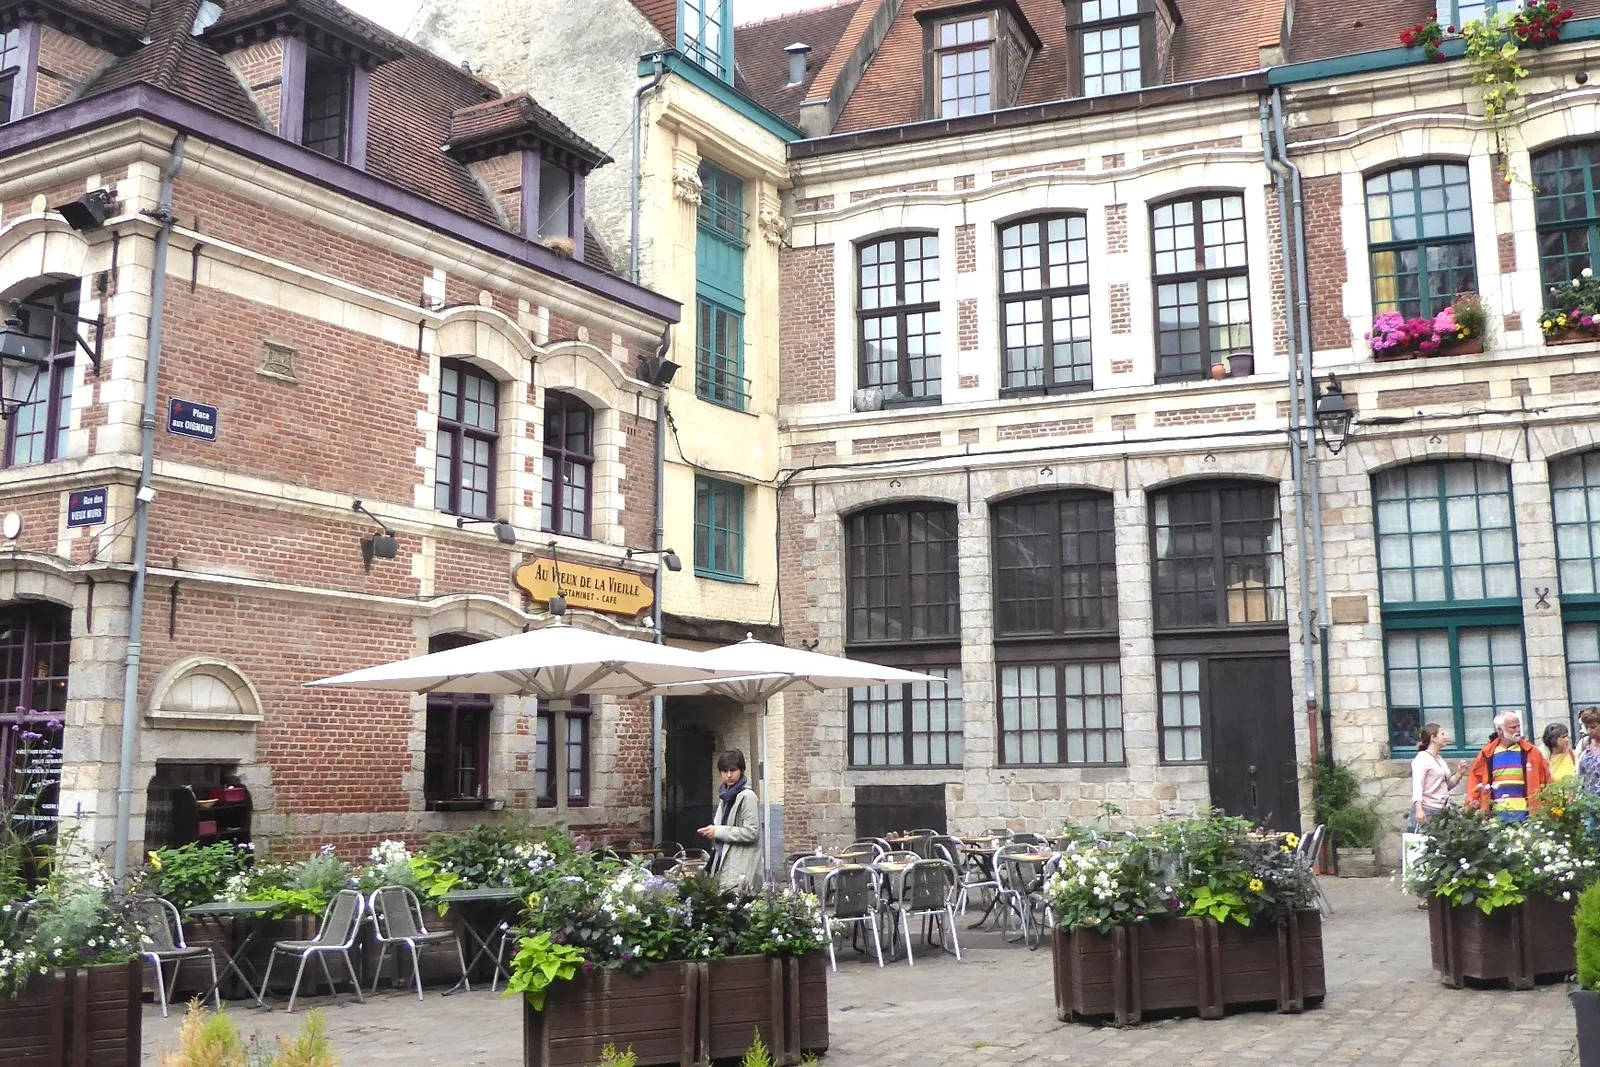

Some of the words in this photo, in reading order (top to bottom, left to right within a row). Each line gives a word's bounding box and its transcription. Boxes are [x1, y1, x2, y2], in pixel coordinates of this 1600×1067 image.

[192, 408, 209, 419] Place
[185, 421, 213, 434] OIGNONS
[84, 496, 93, 504] Rue
[94, 495, 103, 503] des
[71, 510, 86, 520] VIEUX
[86, 508, 102, 518] MURS
[580, 576, 592, 589] DE
[595, 579, 605, 591] LA
[608, 576, 640, 597] VIEILLE
[561, 588, 594, 601] STAMINET
[602, 594, 617, 604] CAFE
